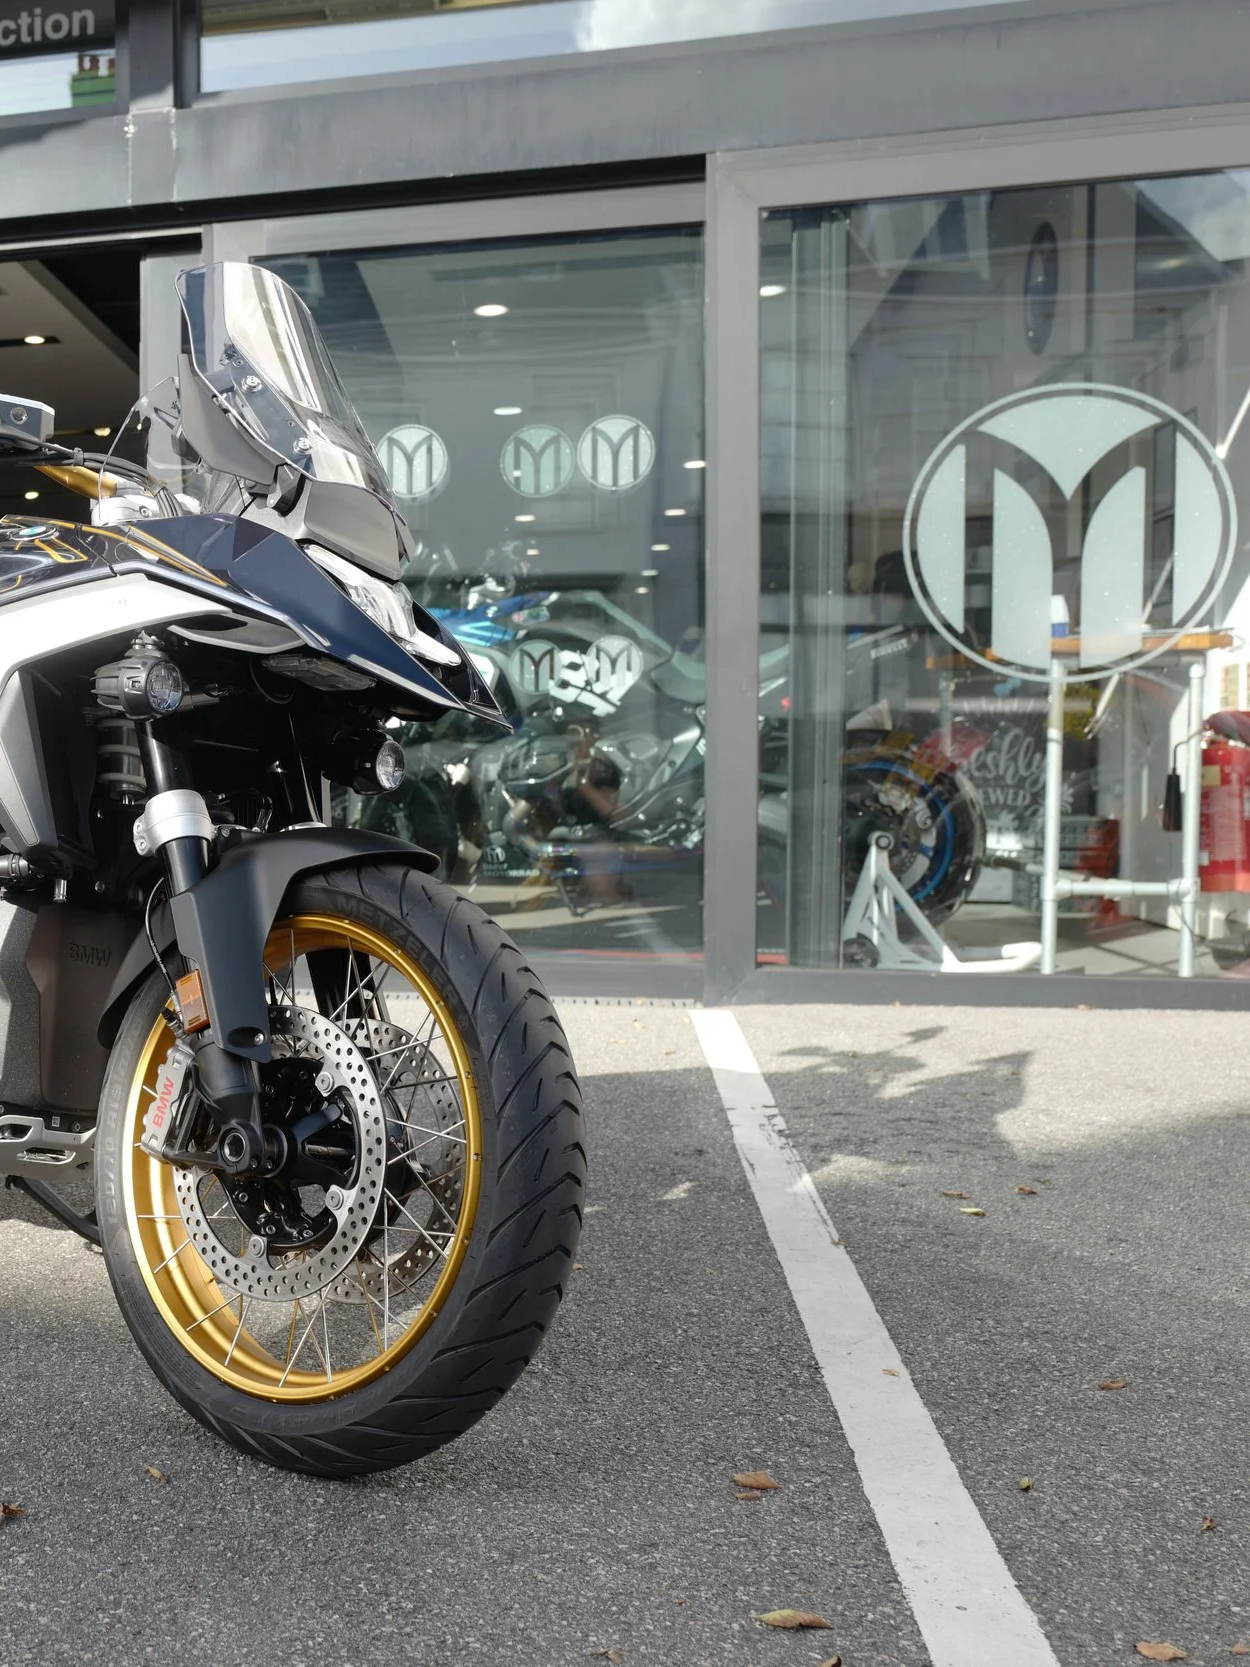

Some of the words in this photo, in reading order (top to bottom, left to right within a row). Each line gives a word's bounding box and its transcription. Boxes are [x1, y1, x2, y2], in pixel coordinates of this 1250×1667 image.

[68, 941, 113, 969] BMW
[336, 893, 460, 1009] METZELER
[151, 1075, 176, 1129] BMW
